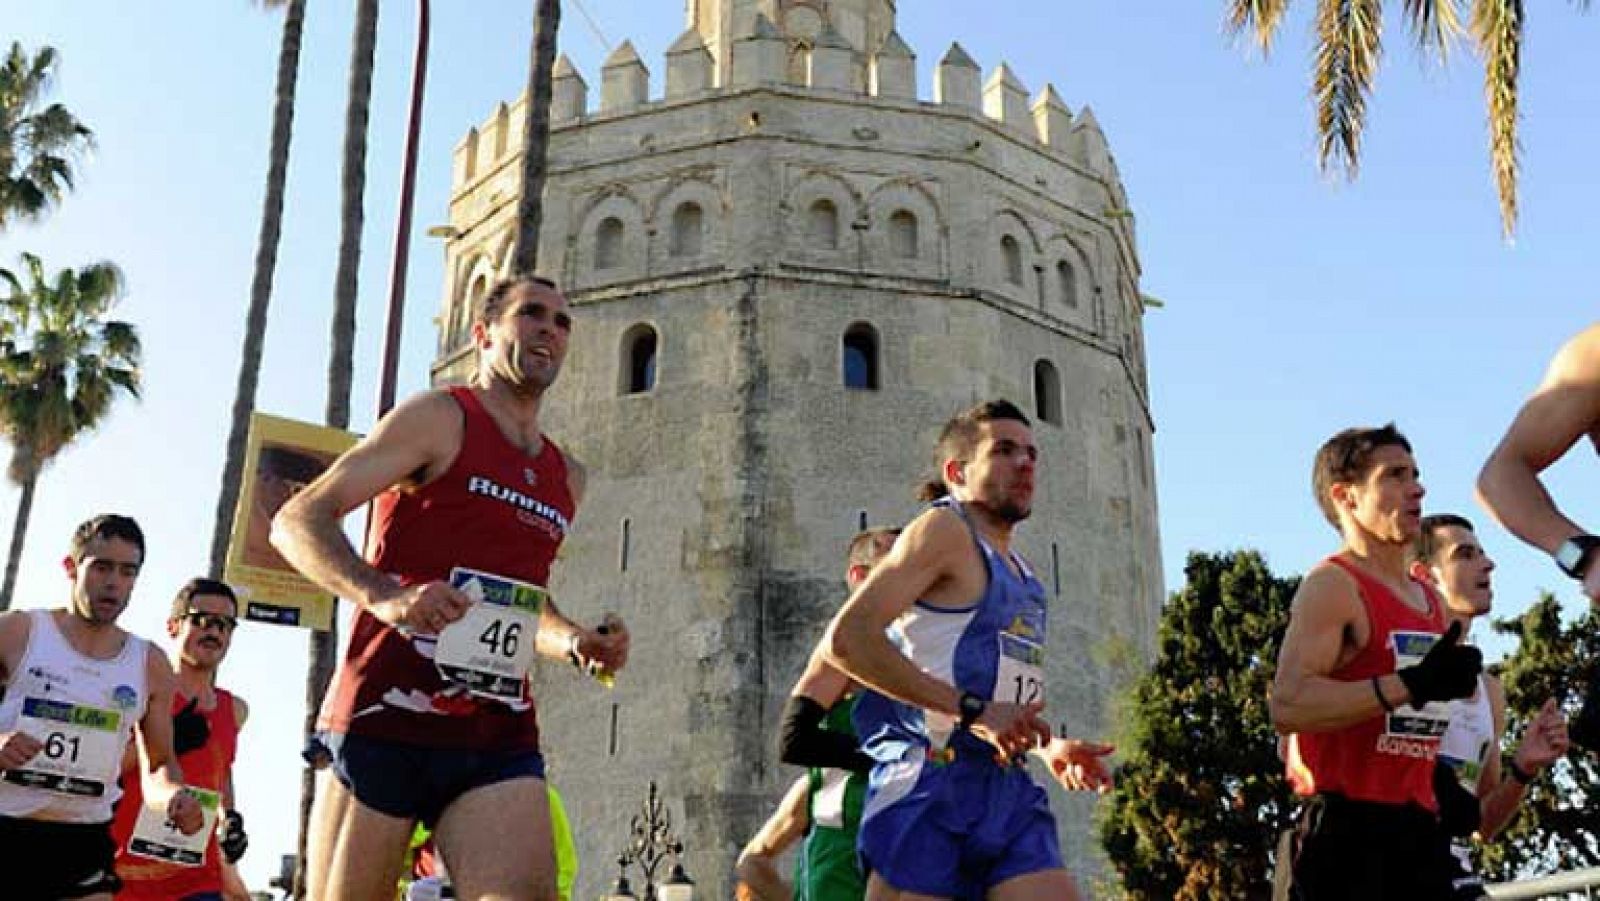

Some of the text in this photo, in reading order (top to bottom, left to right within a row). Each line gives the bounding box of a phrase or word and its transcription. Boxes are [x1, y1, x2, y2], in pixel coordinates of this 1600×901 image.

[468, 475, 569, 531] Runnin
[479, 618, 523, 658] 46
[1013, 673, 1039, 707] 12
[45, 731, 80, 763] 61
